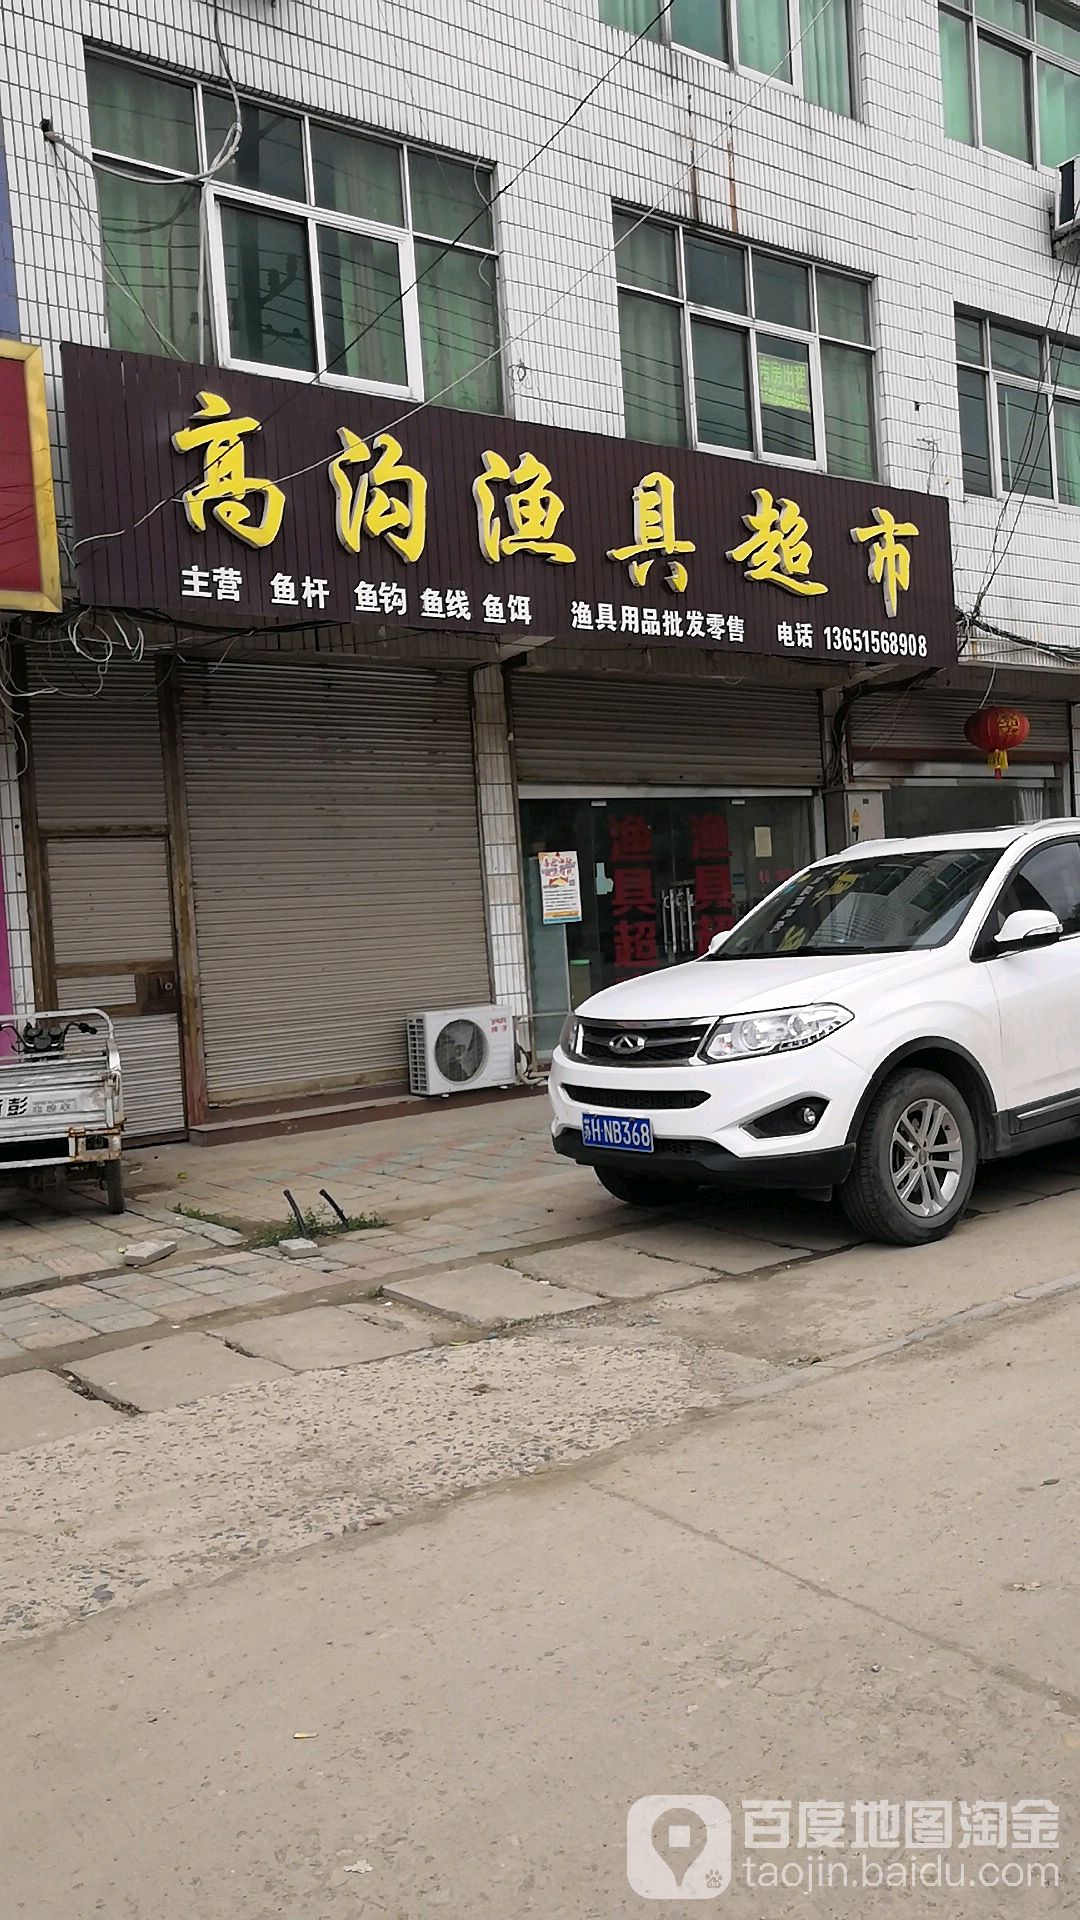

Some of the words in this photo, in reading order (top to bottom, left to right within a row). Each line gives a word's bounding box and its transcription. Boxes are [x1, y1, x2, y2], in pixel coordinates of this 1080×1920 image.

[172, 391, 919, 618] 高沟渔具超市
[181, 565, 243, 602] 主营
[270, 572, 330, 609] 鱼杆
[354, 580, 407, 616] 鱼钩
[420, 587, 472, 621] 鱼线
[483, 593, 532, 625] 鱼饵
[571, 600, 745, 643] 渔具用品批发零售
[777, 622, 814, 649] 电话
[824, 626, 928, 657] 13651568908
